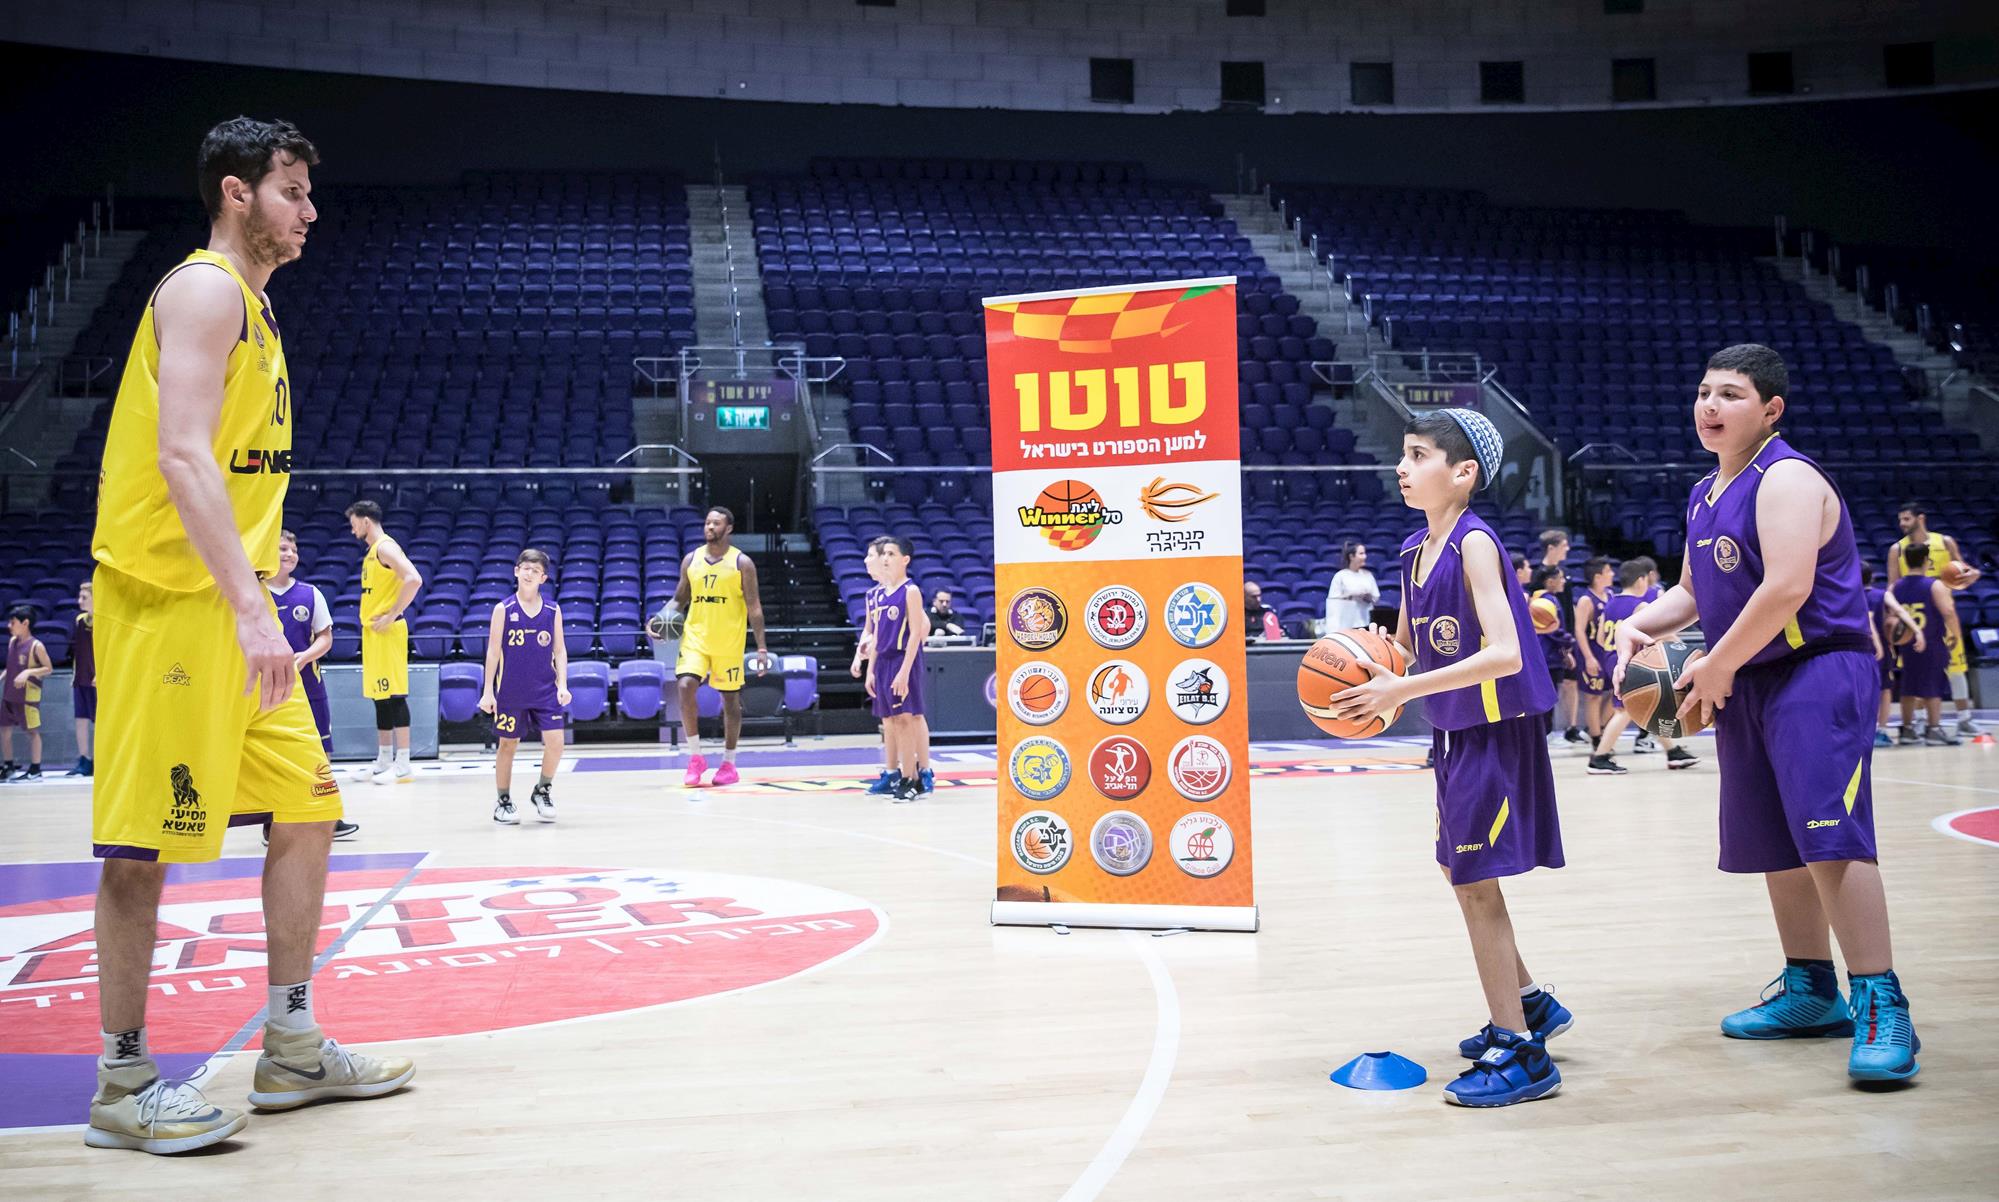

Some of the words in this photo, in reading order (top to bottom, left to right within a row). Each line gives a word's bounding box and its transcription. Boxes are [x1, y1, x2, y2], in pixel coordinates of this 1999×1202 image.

[1014, 360, 1207, 432] טוטו
[1020, 439, 1090, 458] בישראל
[1093, 436, 1161, 456] הספורט
[1164, 430, 1207, 456] למען
[1070, 499, 1100, 513] ליגת
[1018, 506, 1101, 527] Winner
[1101, 506, 1122, 524] סל
[1146, 529, 1205, 542] מנהלת
[1150, 539, 1201, 552] הליגה
[703, 574, 717, 588] 17
[1093, 591, 1118, 608] ירושלים
[1120, 591, 1140, 607] הפועל
[508, 629, 525, 647] 23
[162, 675, 190, 687] PEAK
[726, 667, 740, 682] 17
[376, 677, 390, 692] 19
[1589, 678, 1604, 690] 30
[1099, 706, 1125, 714] ציונה
[1127, 706, 1139, 714] נס
[496, 713, 516, 732] 23
[162, 819, 206, 832] שאשא
[1807, 819, 1840, 830] DERBY
[1455, 842, 1484, 854] DERBY
[0, 897, 764, 985] ENTER
[634, 918, 857, 950] מכירה
[287, 984, 308, 1015] PEAK
